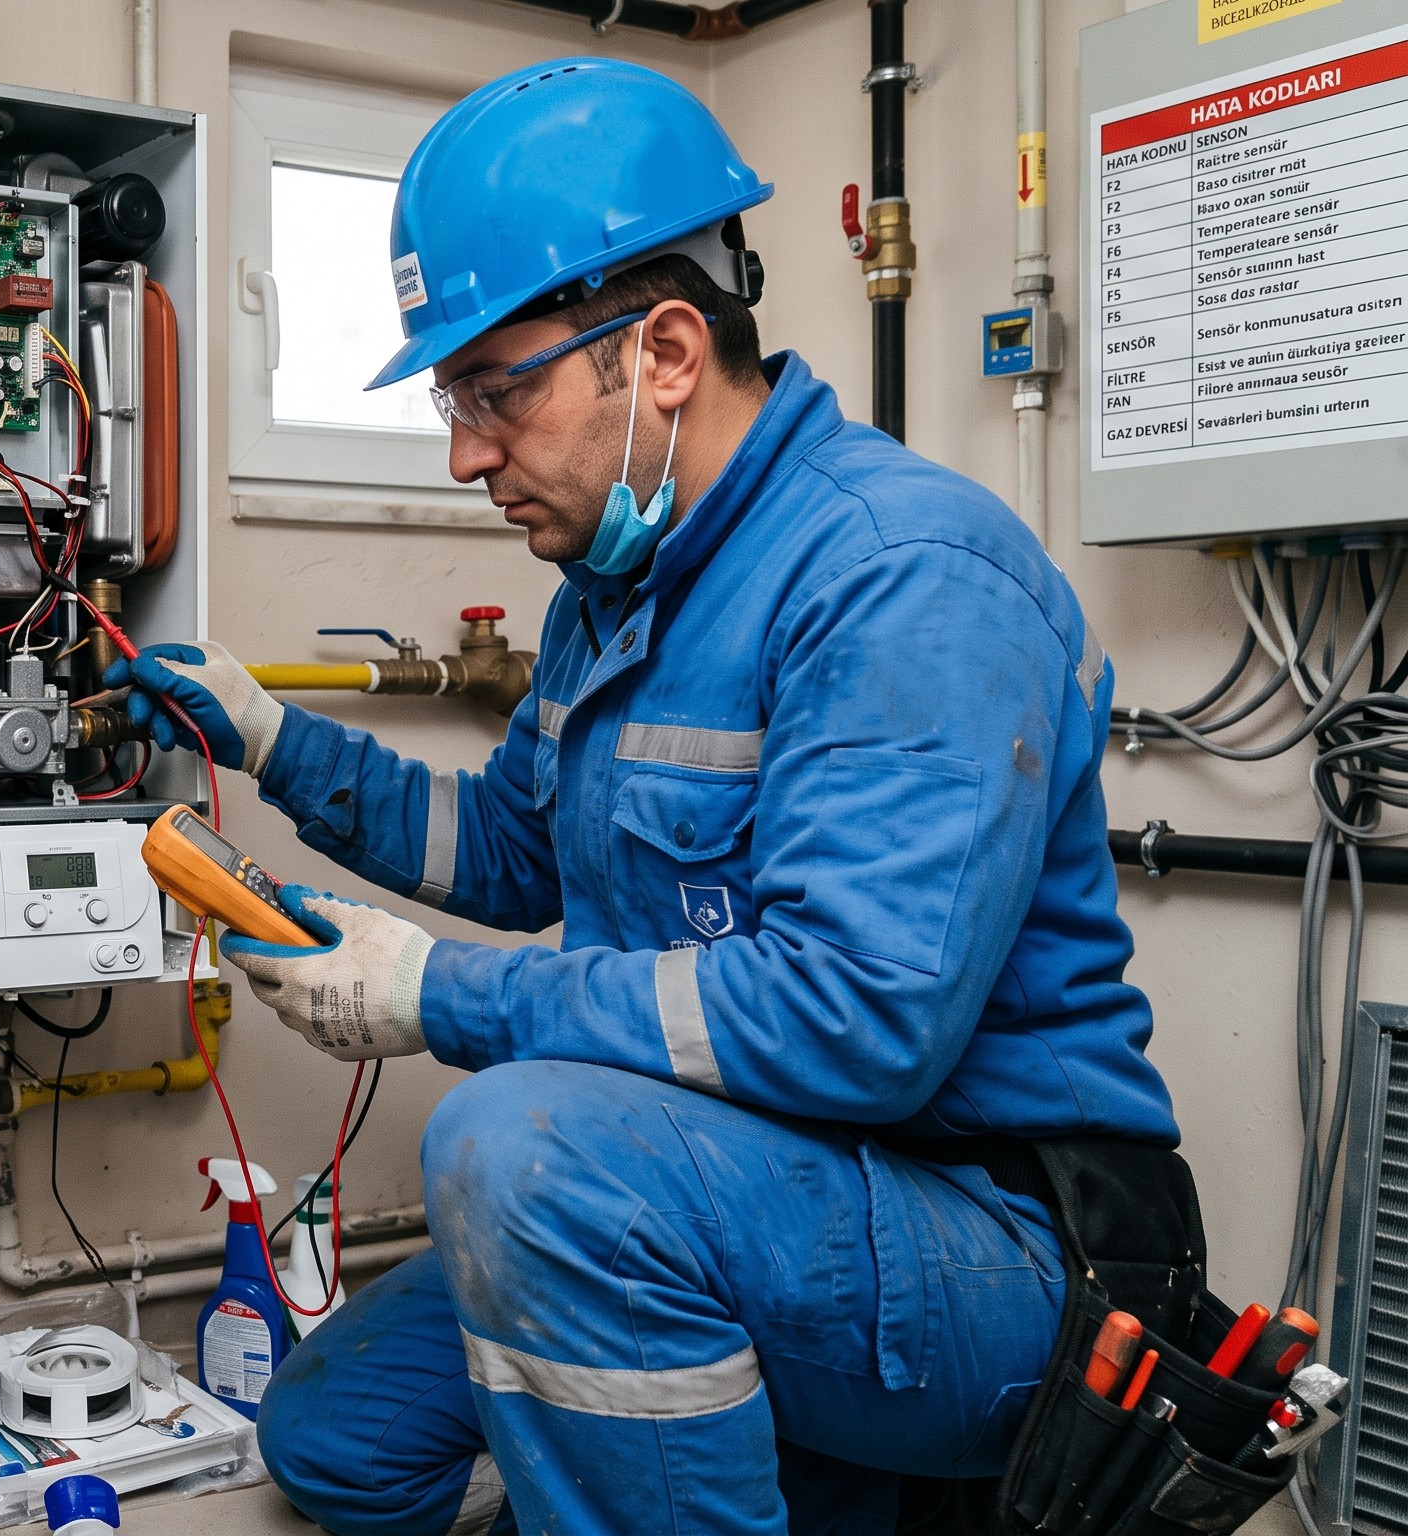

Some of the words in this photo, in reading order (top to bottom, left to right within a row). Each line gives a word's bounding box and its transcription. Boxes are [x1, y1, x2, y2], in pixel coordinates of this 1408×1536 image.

[1190, 97, 1243, 125] HATA
[1248, 68, 1342, 109] KODLARI
[1196, 125, 1248, 148] SENSON
[1107, 153, 1138, 171] HATA
[1141, 139, 1187, 162] KODNU
[1107, 180, 1121, 193] F2
[1197, 177, 1228, 193] Baso
[1107, 201, 1121, 215] F2
[1107, 223, 1121, 236] F3
[1197, 210, 1291, 239] Temperateare
[1107, 245, 1122, 259] F6
[1197, 234, 1290, 261] Temperateare
[1107, 267, 1122, 280] F4
[1107, 289, 1122, 302] F5
[1107, 311, 1122, 324] F5
[1197, 323, 1241, 340] Sensör
[1106, 335, 1156, 355] SENSÖR
[1229, 357, 1244, 369] ve
[1107, 371, 1146, 387] FİLTRE
[1107, 395, 1131, 409] FAN
[1107, 427, 1132, 441] GAZ
[1135, 417, 1188, 438] DEVRESİ
